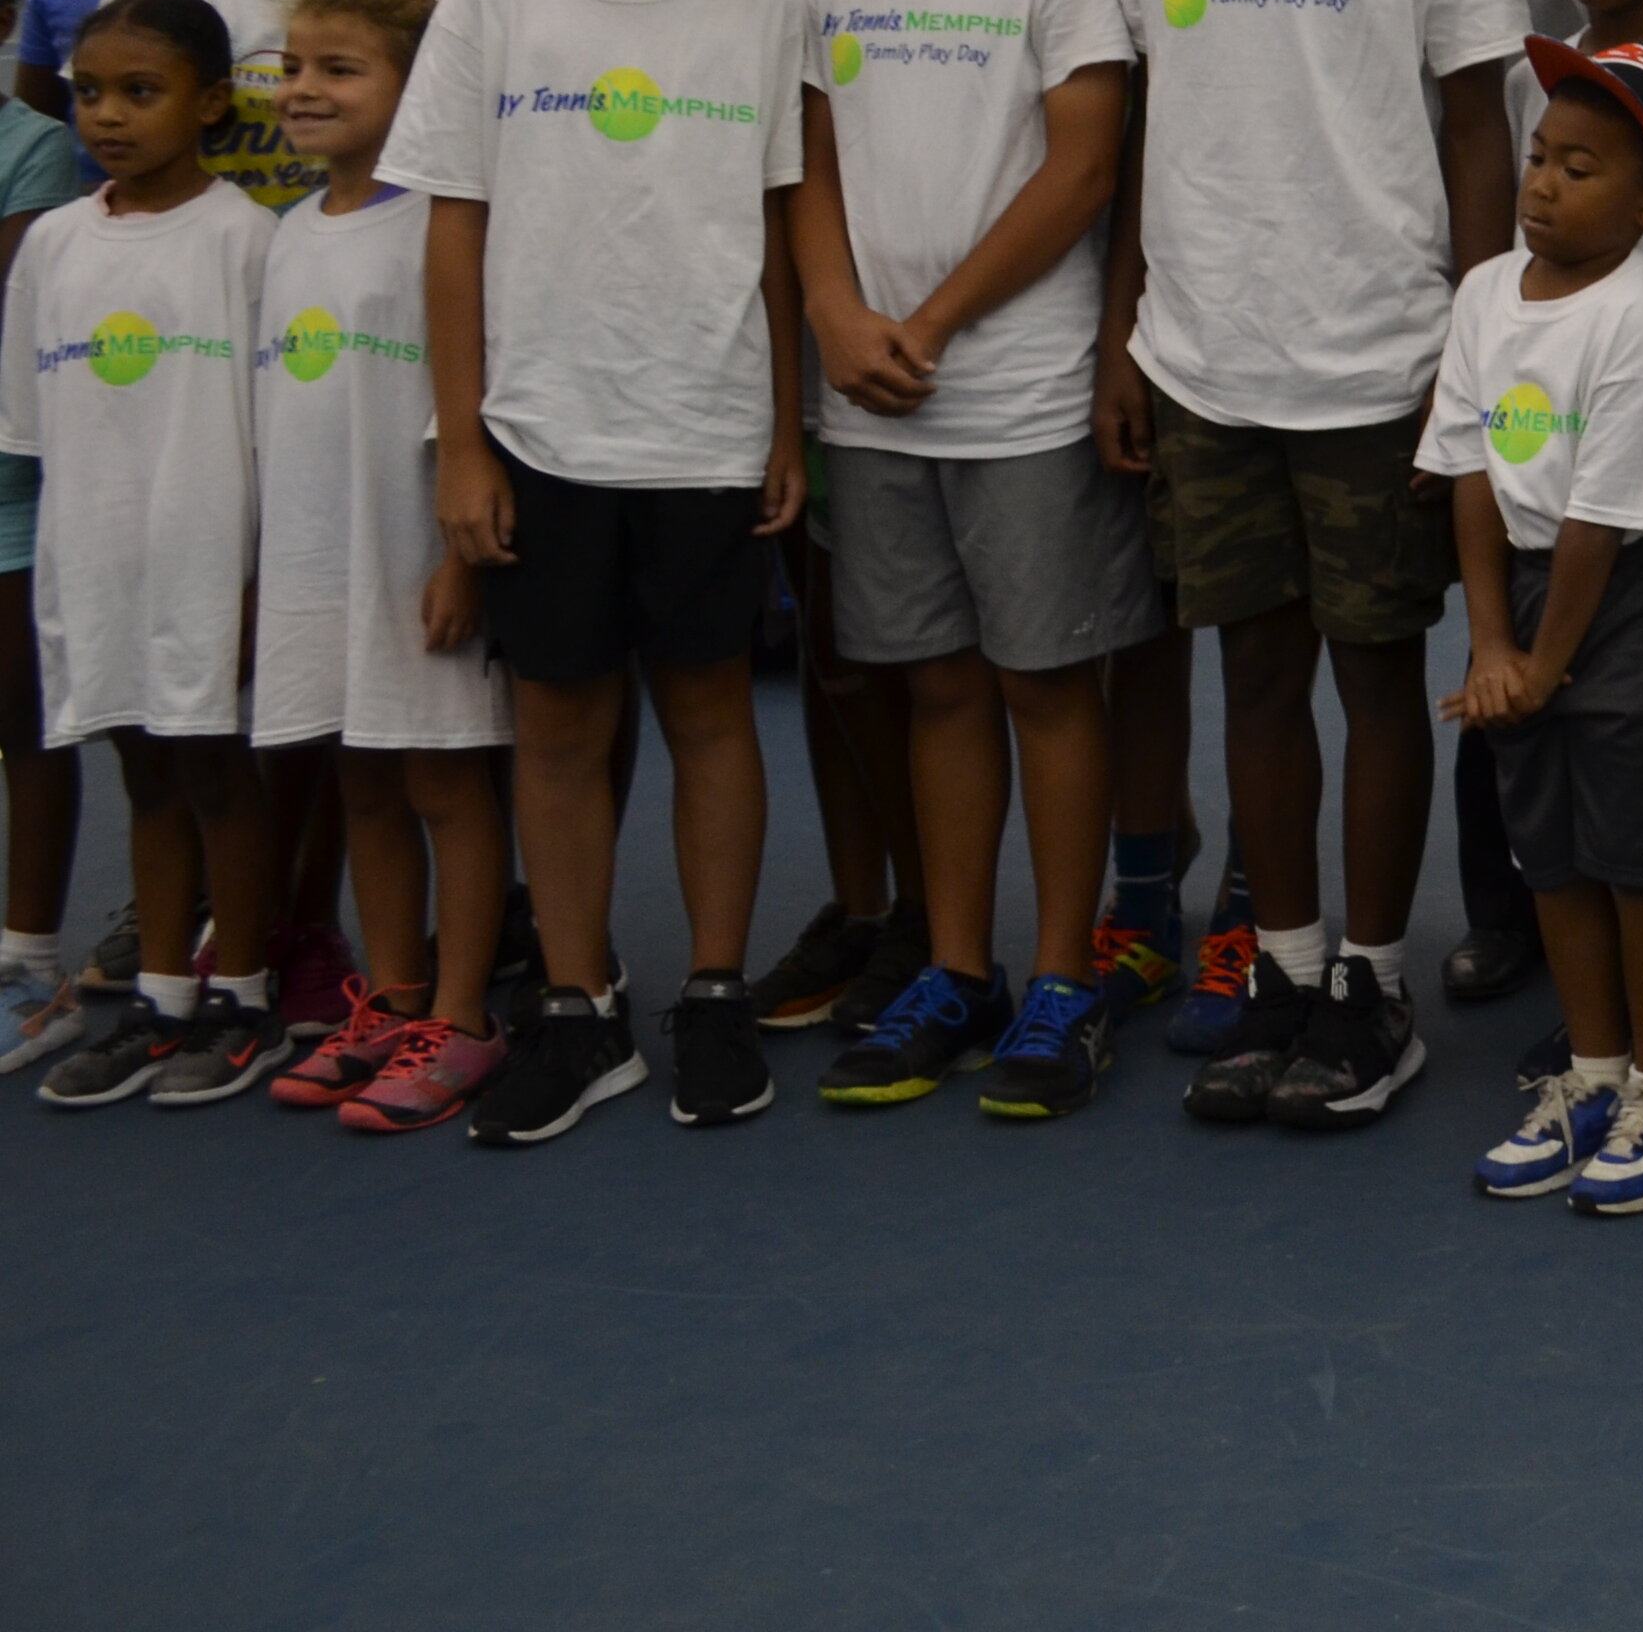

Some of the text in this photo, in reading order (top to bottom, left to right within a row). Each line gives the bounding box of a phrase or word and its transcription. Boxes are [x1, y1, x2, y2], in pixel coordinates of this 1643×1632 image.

[864, 43, 991, 68] Family Play Day
